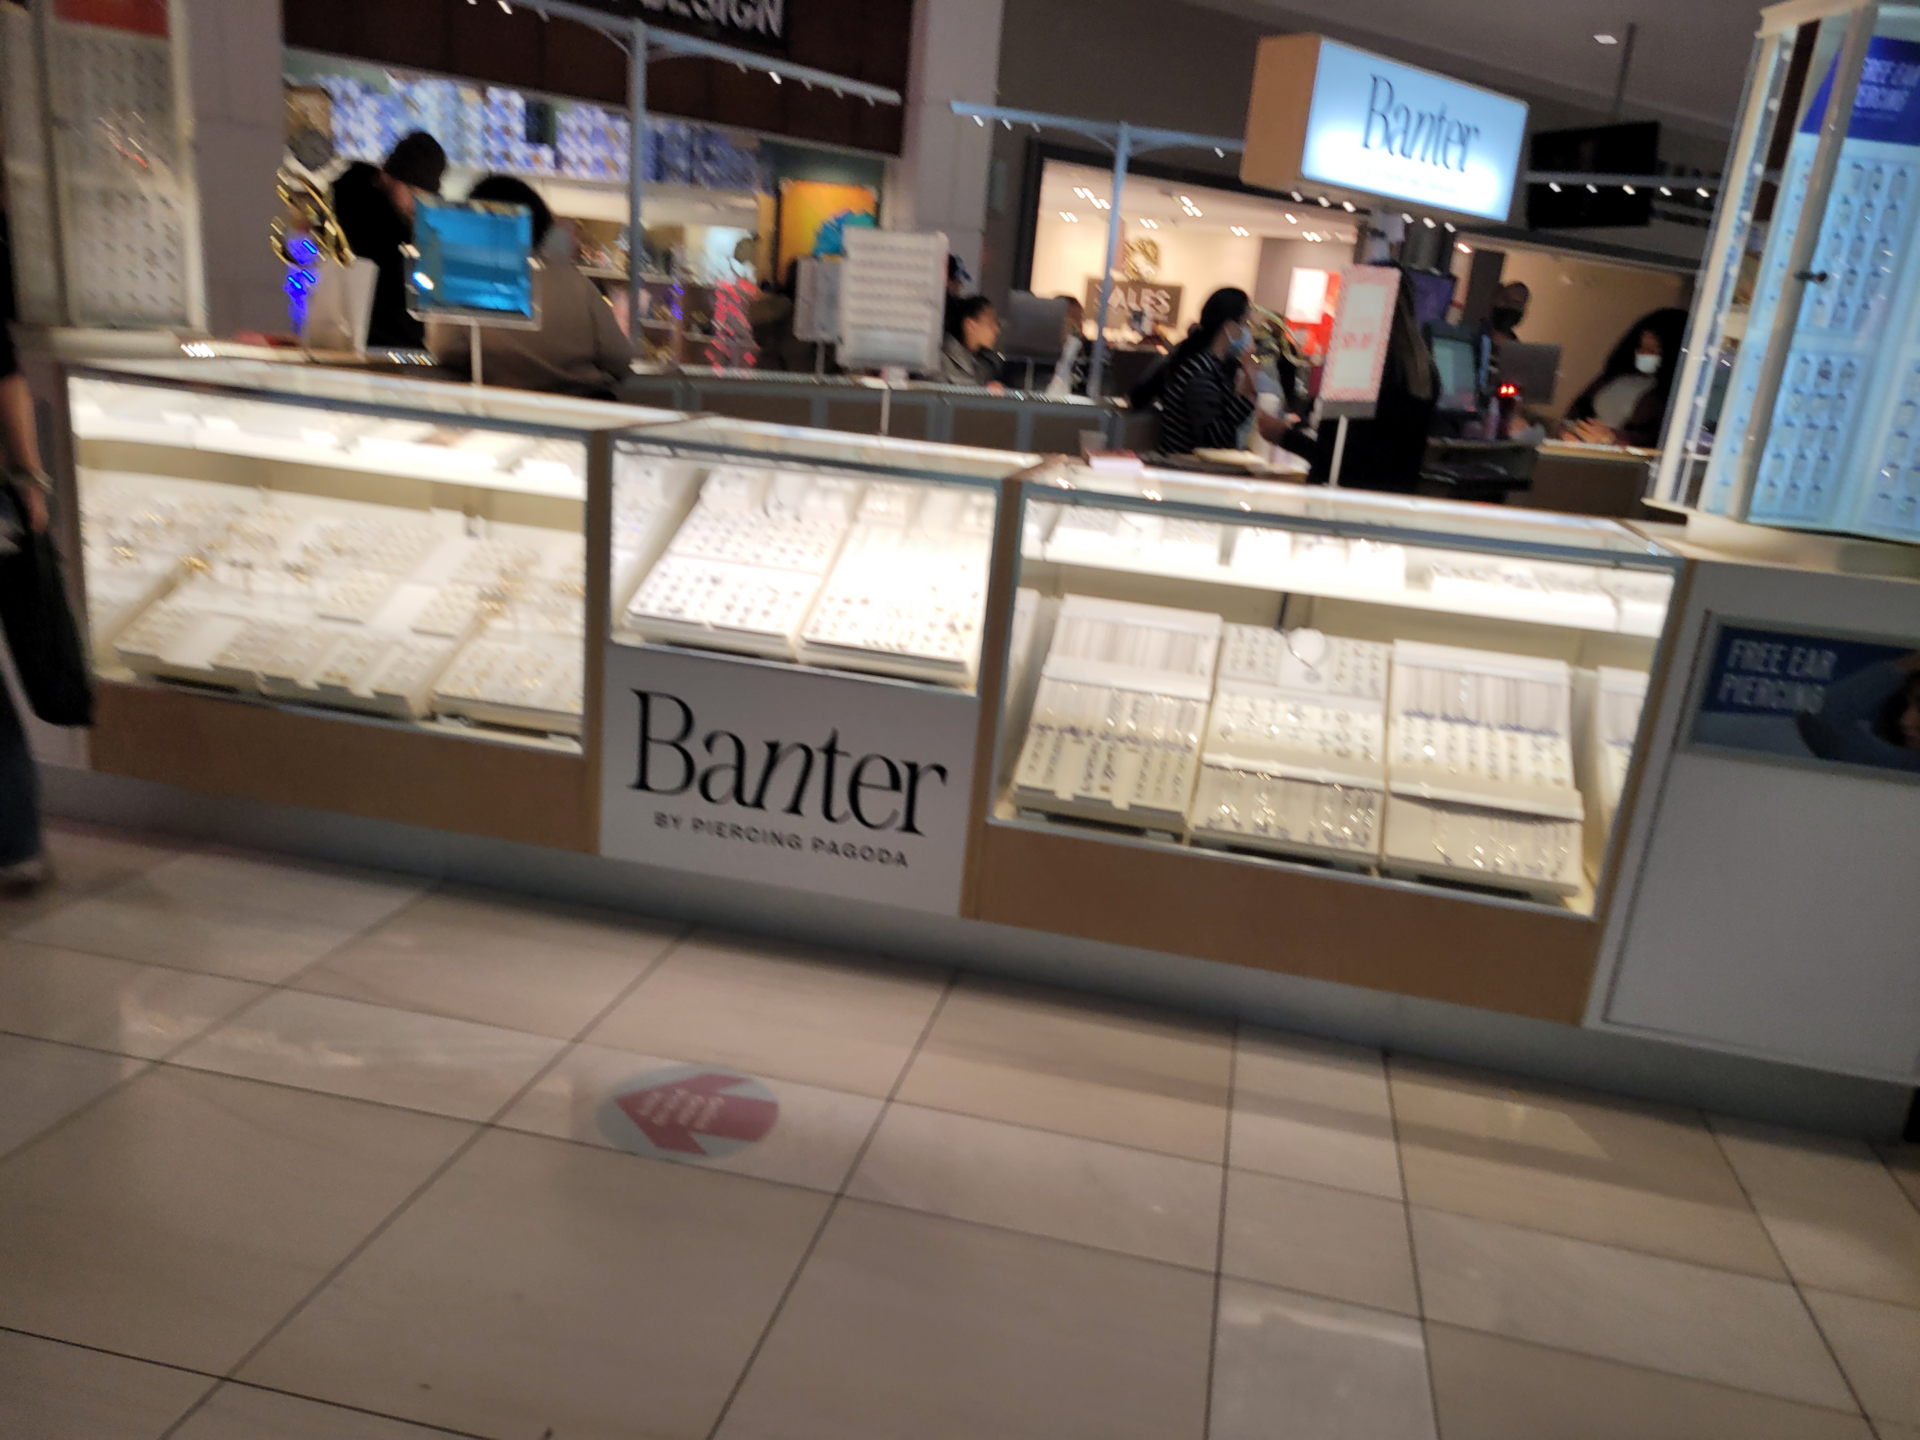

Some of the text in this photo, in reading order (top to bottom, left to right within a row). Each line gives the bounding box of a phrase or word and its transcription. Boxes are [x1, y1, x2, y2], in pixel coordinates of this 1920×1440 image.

[641, 0, 784, 38] SIGN
[1362, 72, 1481, 173] Banter
[626, 688, 949, 837] Banter
[653, 811, 909, 868] BY PIERCING PAGODA
